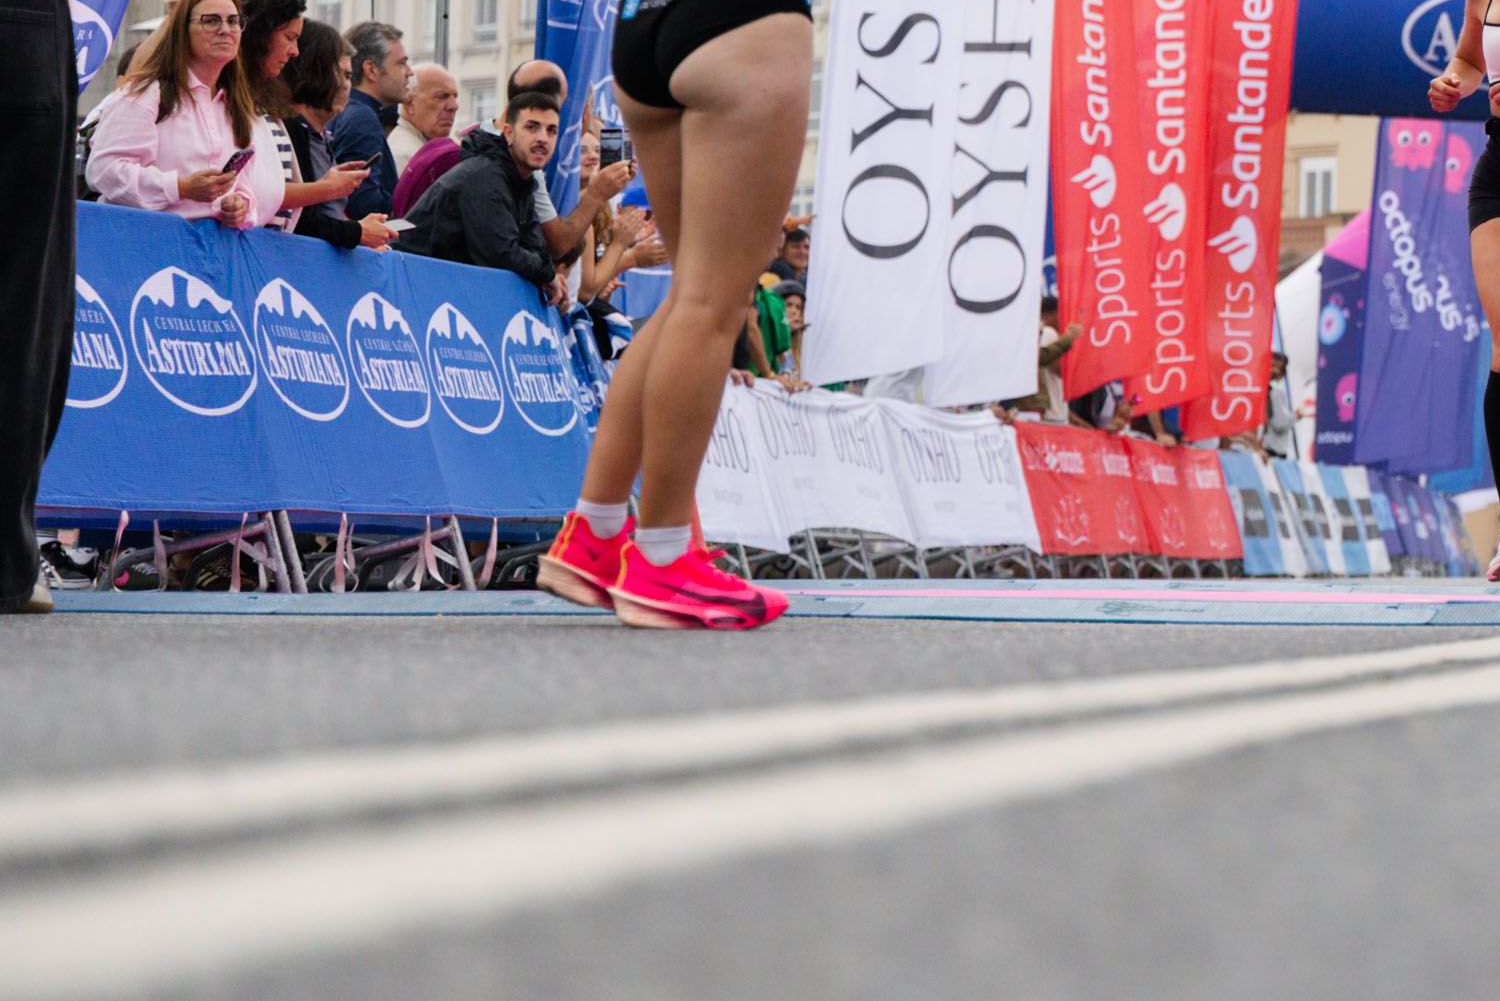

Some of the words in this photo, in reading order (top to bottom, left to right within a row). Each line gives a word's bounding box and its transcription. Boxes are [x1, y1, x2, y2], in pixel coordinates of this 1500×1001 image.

[1086, 212, 1138, 350] Sports
[1378, 189, 1434, 314] octopus
[154, 316, 196, 333] CENTRAL
[261, 324, 347, 387] ASTURIANA
[432, 346, 502, 402] ASTURIANA
[1146, 245, 1196, 396] Sports
[1212, 279, 1262, 423] Sports
